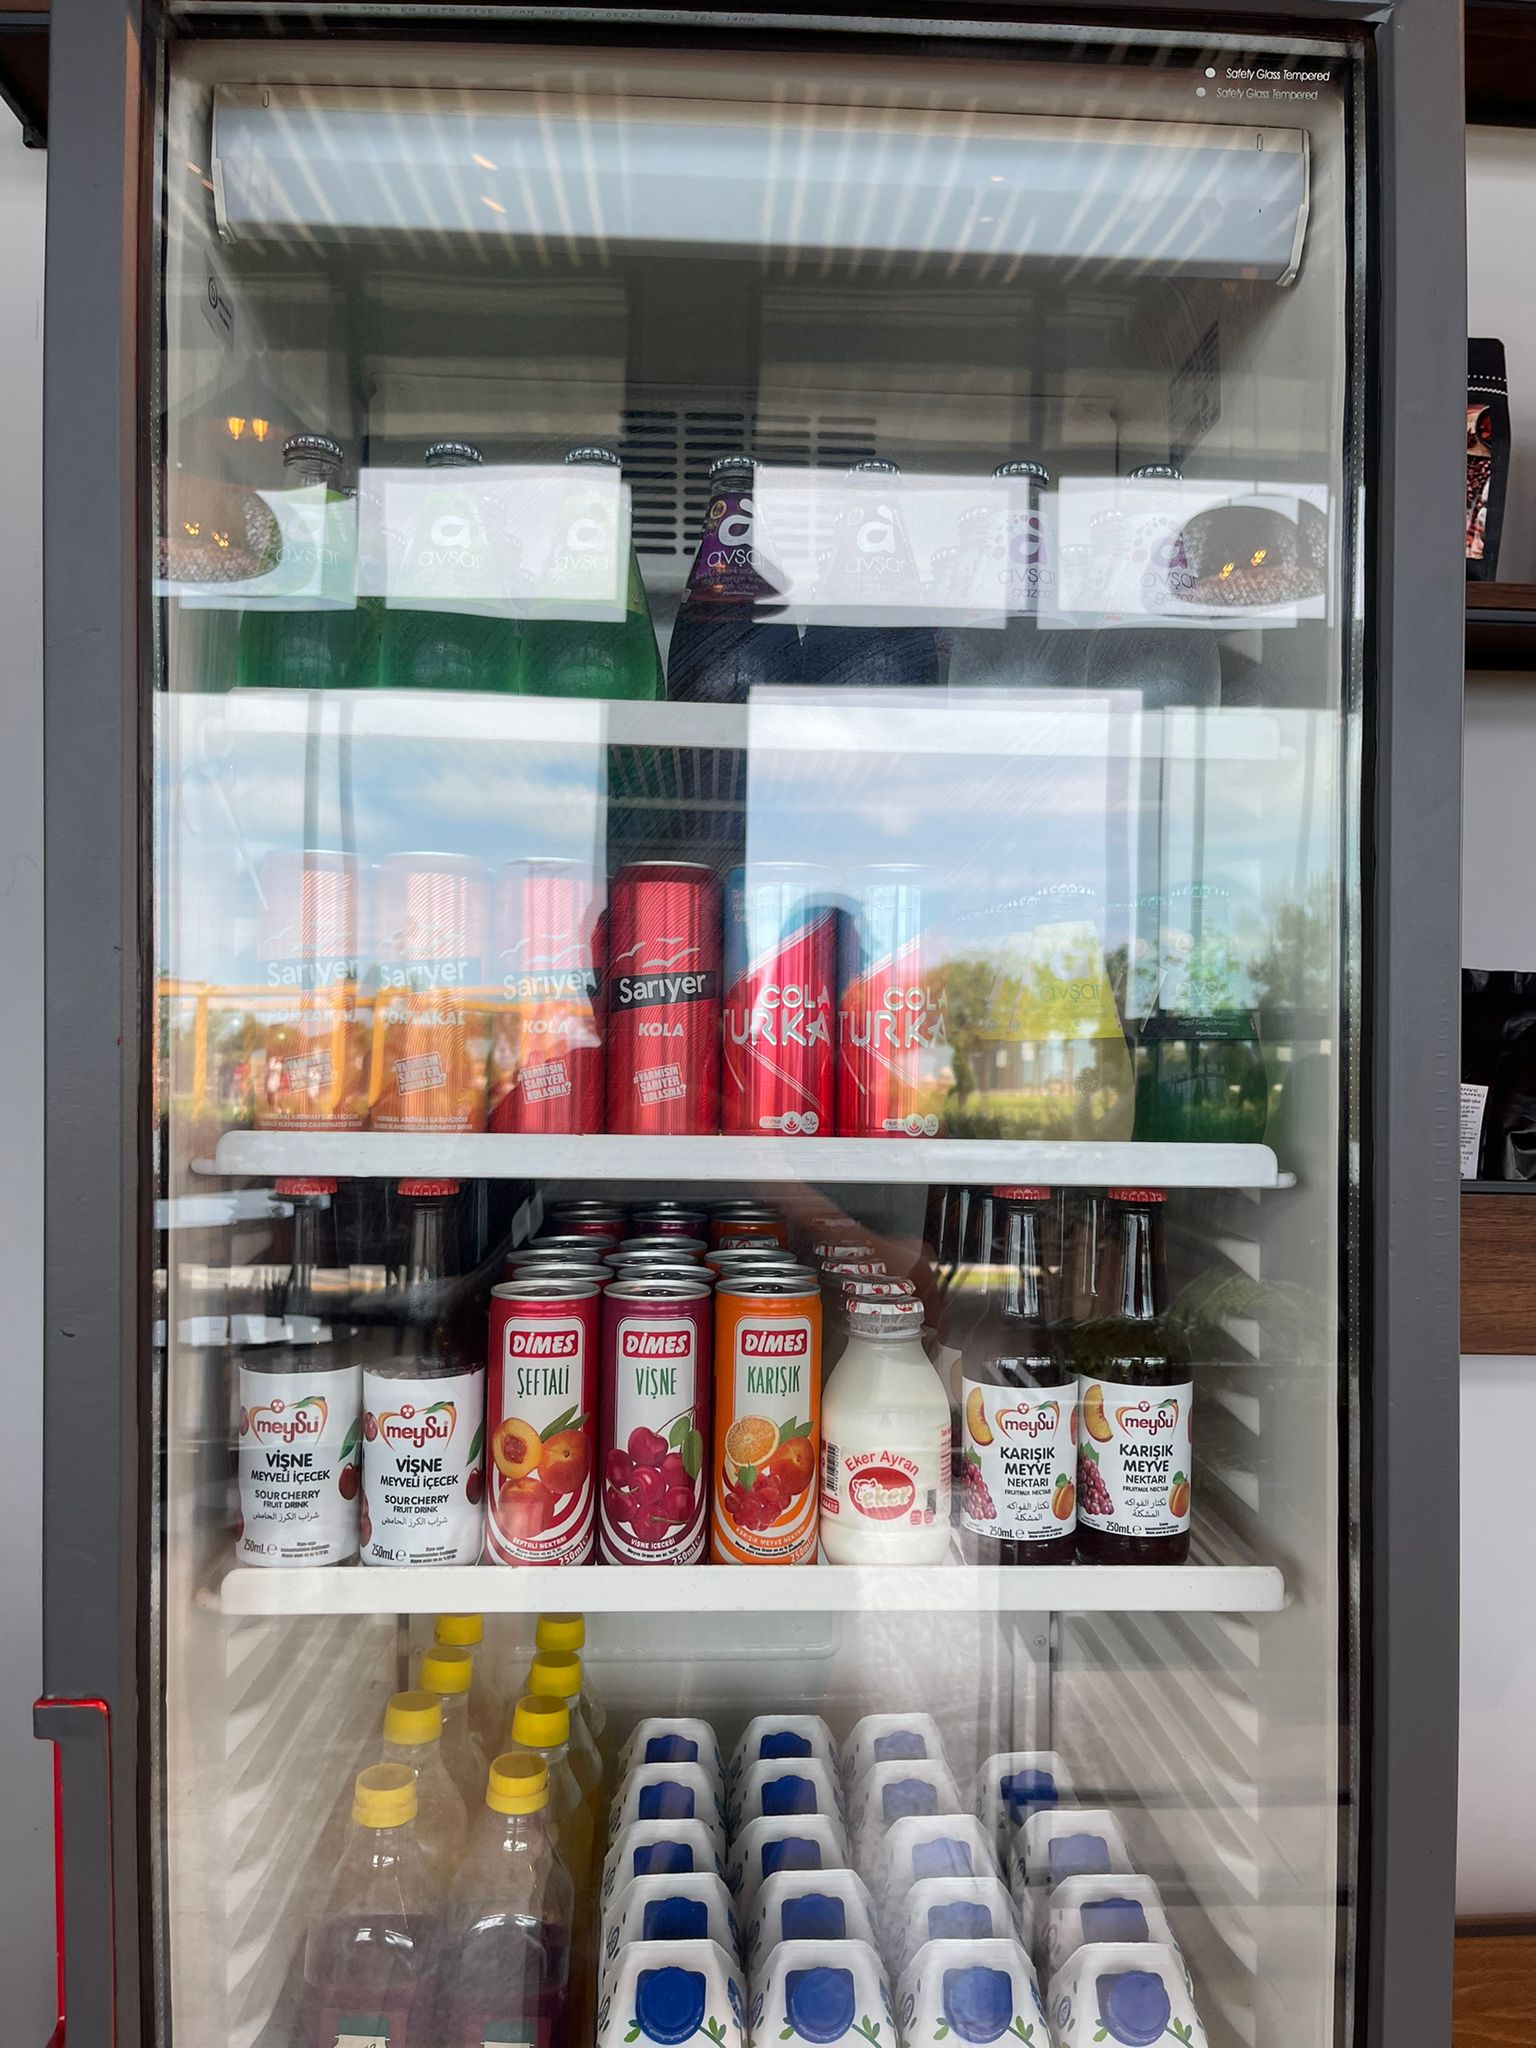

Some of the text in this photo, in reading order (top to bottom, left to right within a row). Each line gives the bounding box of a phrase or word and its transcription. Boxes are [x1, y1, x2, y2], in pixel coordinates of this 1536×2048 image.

[1226, 67, 1330, 82] Safety Glass Tempered
[1216, 87, 1319, 101] Safety Glass Tempered
[619, 974, 706, 1004] Sarıyer
[759, 983, 830, 1009] COLA
[883, 985, 948, 1012] COLA
[522, 1019, 569, 1034] KOLA
[638, 1022, 685, 1037] KOLA
[838, 1009, 949, 1049] TURKA
[513, 1332, 575, 1354] DİMES
[626, 1332, 687, 1354] DİMES
[745, 1331, 804, 1353] DİMES
[517, 1364, 570, 1399] ŞEFTALİ
[635, 1366, 678, 1400] VİŞNE
[747, 1364, 801, 1397] KARIŞIK
[265, 1449, 313, 1472] VİŞNE
[1000, 1446, 1056, 1463] KARIŞIK
[1119, 1443, 1174, 1461] KARIŞIK
[396, 1454, 443, 1477] VİŞNE
[844, 1452, 876, 1472] Eker
[879, 1449, 919, 1476] Ayran
[1004, 1462, 1051, 1476] MEYVE
[1123, 1459, 1170, 1473] MEYVE
[250, 1469, 331, 1485] MEYVELİ İÇECEK
[380, 1474, 459, 1490] MEYVELİ İÇECEK
[1007, 1477, 1049, 1488] NEKTARI
[1125, 1474, 1167, 1485] NEKTARI
[862, 1484, 912, 1508] eker
[1031, 1488, 1052, 1496] NECTAR
[263, 1500, 309, 1509] FRUIT DRINK
[393, 1505, 438, 1514] FRUIT DRINK
[989, 1525, 1015, 1539] 250mL
[1105, 1520, 1132, 1535] 250mL
[371, 1543, 395, 1561] 250mL
